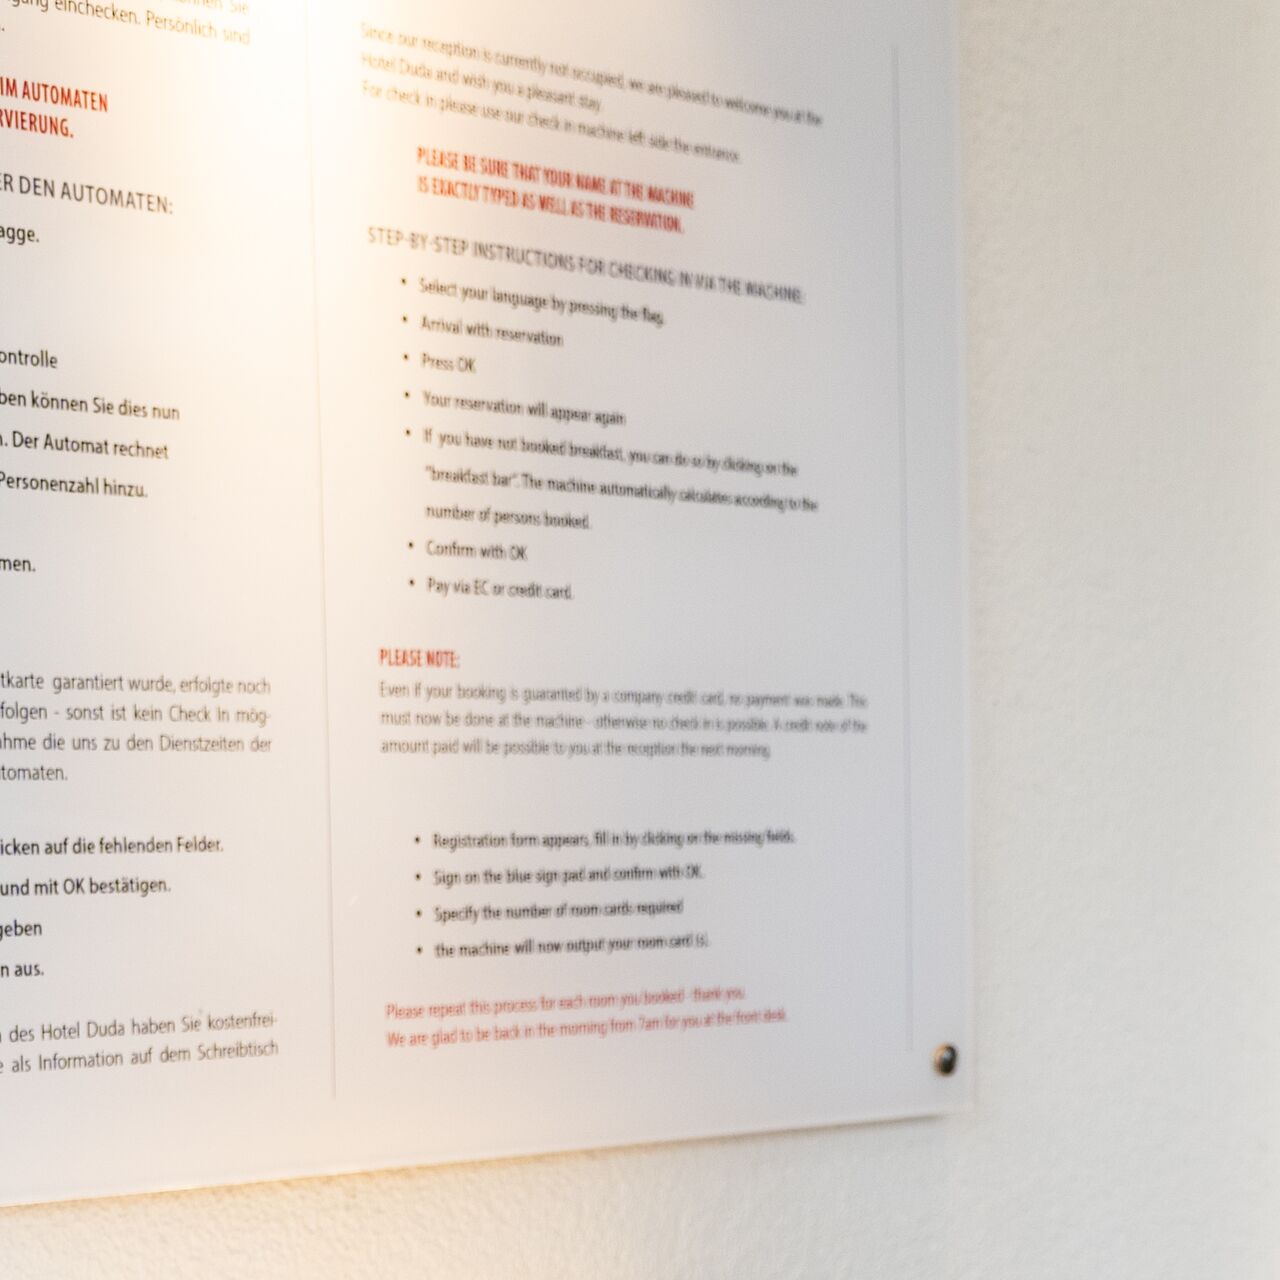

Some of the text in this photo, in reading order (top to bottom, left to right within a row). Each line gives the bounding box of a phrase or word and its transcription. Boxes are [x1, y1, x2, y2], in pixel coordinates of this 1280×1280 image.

[22, 80, 108, 112] AUTOMATEN
[19, 175, 54, 198] DEN
[60, 181, 172, 214] AUTOMATEN:
[30, 391, 88, 412] können
[92, 396, 114, 415] Sie
[118, 399, 148, 418] dies
[151, 406, 180, 420] nun
[12, 430, 38, 449] Der
[43, 434, 108, 454] Automat
[112, 441, 169, 460] rechnet
[102, 477, 148, 498] hinzu.
[52, 674, 123, 695] garantiert
[127, 675, 175, 695] wurde,
[178, 675, 234, 698] erfolgte
[234, 678, 271, 694] noch
[65, 705, 104, 721] sonst
[110, 704, 126, 721] ist
[132, 705, 162, 721] kein
[167, 704, 211, 722] Check
[234, 706, 272, 728] mög-
[42, 732, 65, 750] die
[71, 737, 97, 750] uns
[102, 737, 120, 751] zu
[126, 734, 153, 751] den
[158, 734, 244, 752] Dienstzeiten
[249, 736, 272, 752] der
[44, 837, 68, 854] auf
[72, 837, 94, 854] die
[98, 836, 172, 853] fehlenden
[175, 835, 223, 852] Felder.
[0, 877, 171, 898] und mit OK bestätigen.
[14, 964, 44, 976] aus.
[9, 1024, 35, 1042] des
[42, 1022, 80, 1040] Hotel
[85, 1018, 125, 1038] Duda
[130, 1016, 175, 1035] haben
[180, 1015, 201, 1032] Sie
[206, 1011, 277, 1030] kostenfrei-
[11, 1054, 31, 1073] als
[37, 1049, 123, 1071] Information
[129, 1046, 152, 1065] auf
[159, 1044, 191, 1063] dem
[196, 1038, 279, 1060] Schreibtisch
